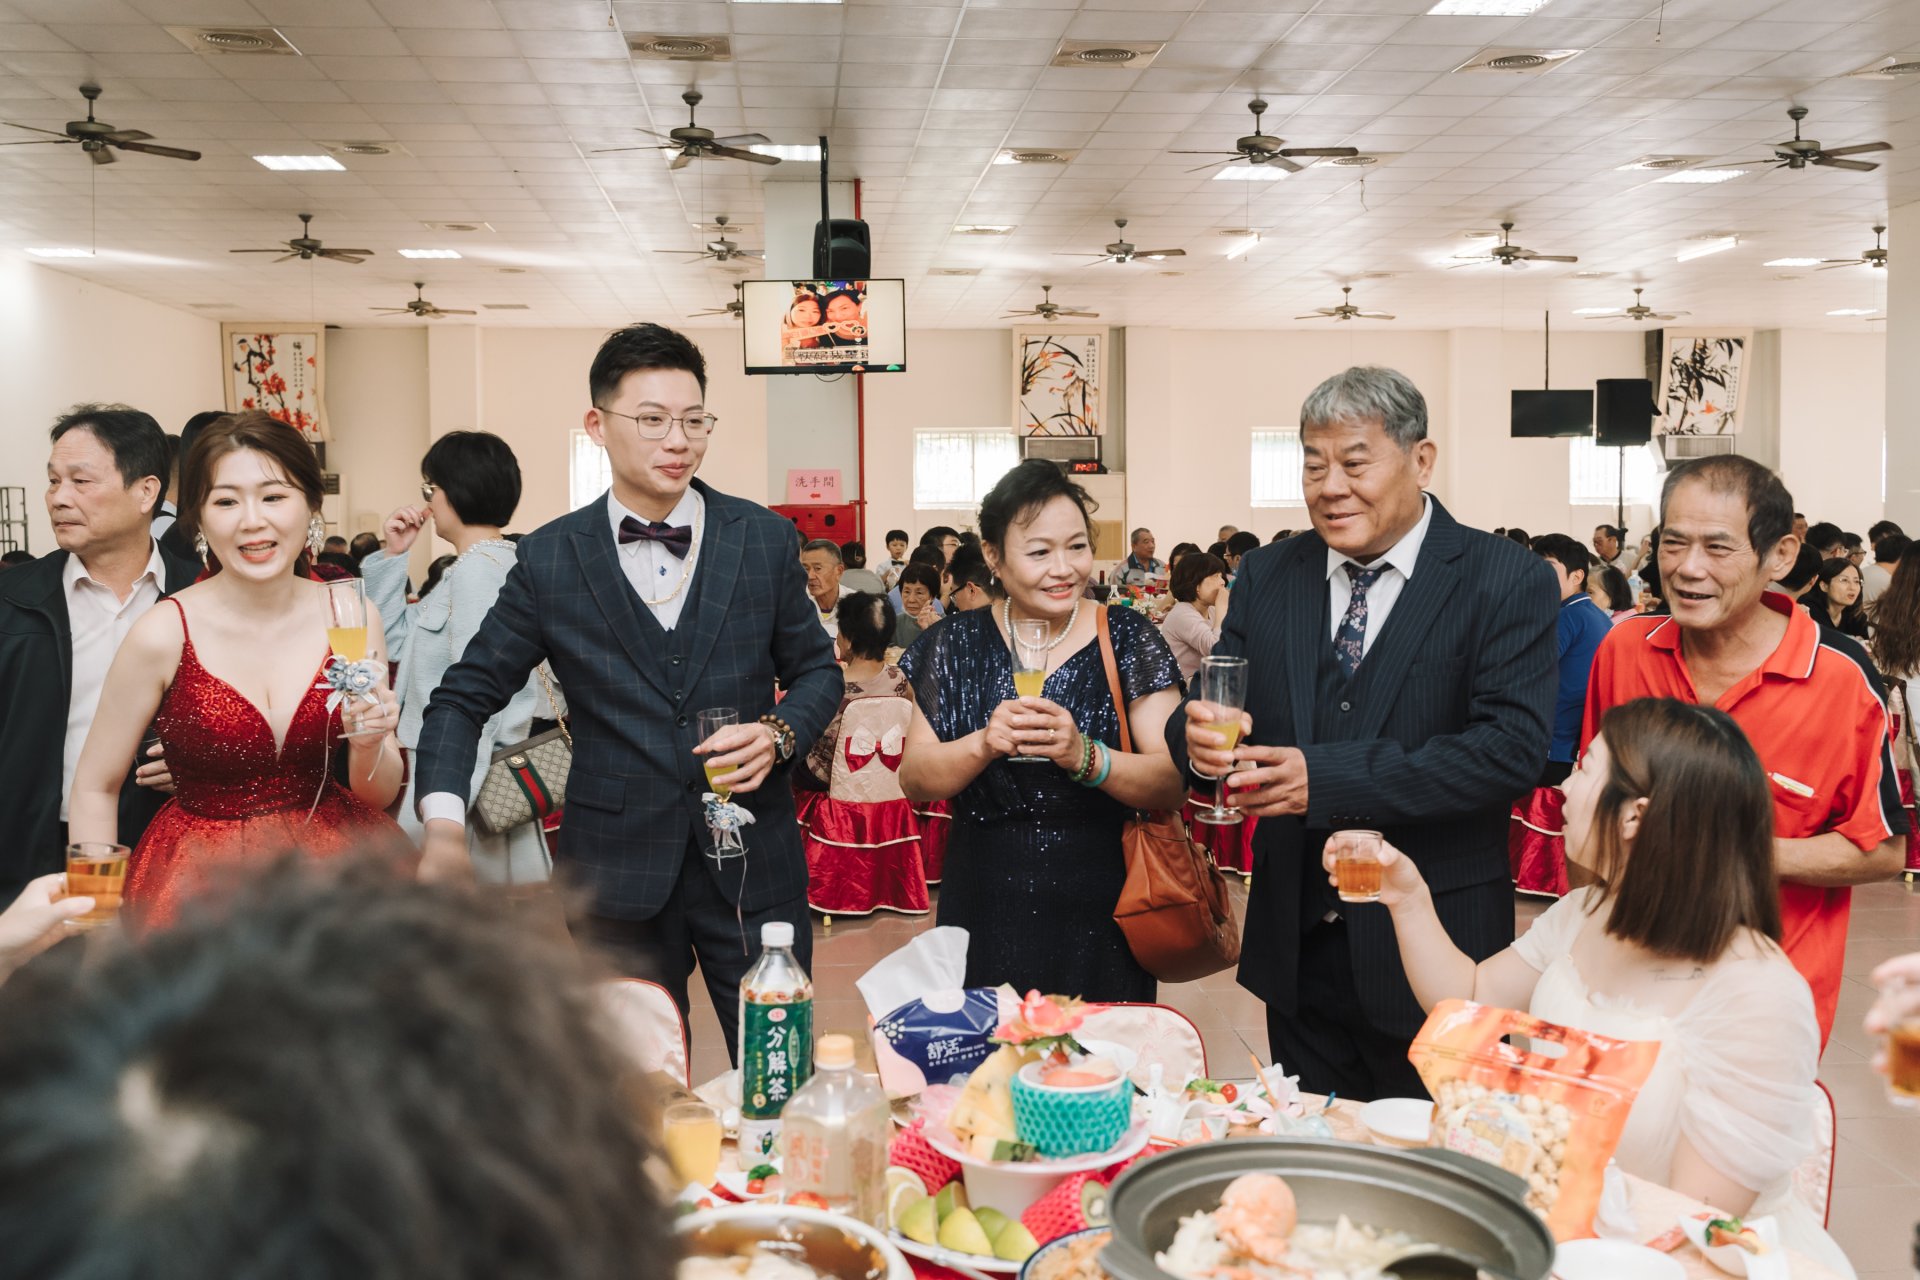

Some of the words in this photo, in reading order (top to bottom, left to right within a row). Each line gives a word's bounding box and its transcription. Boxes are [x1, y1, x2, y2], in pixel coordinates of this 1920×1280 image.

[795, 476, 834, 488] 洗手間
[926, 1037, 960, 1060] 舒活
[766, 1026, 788, 1102] 分解茶
